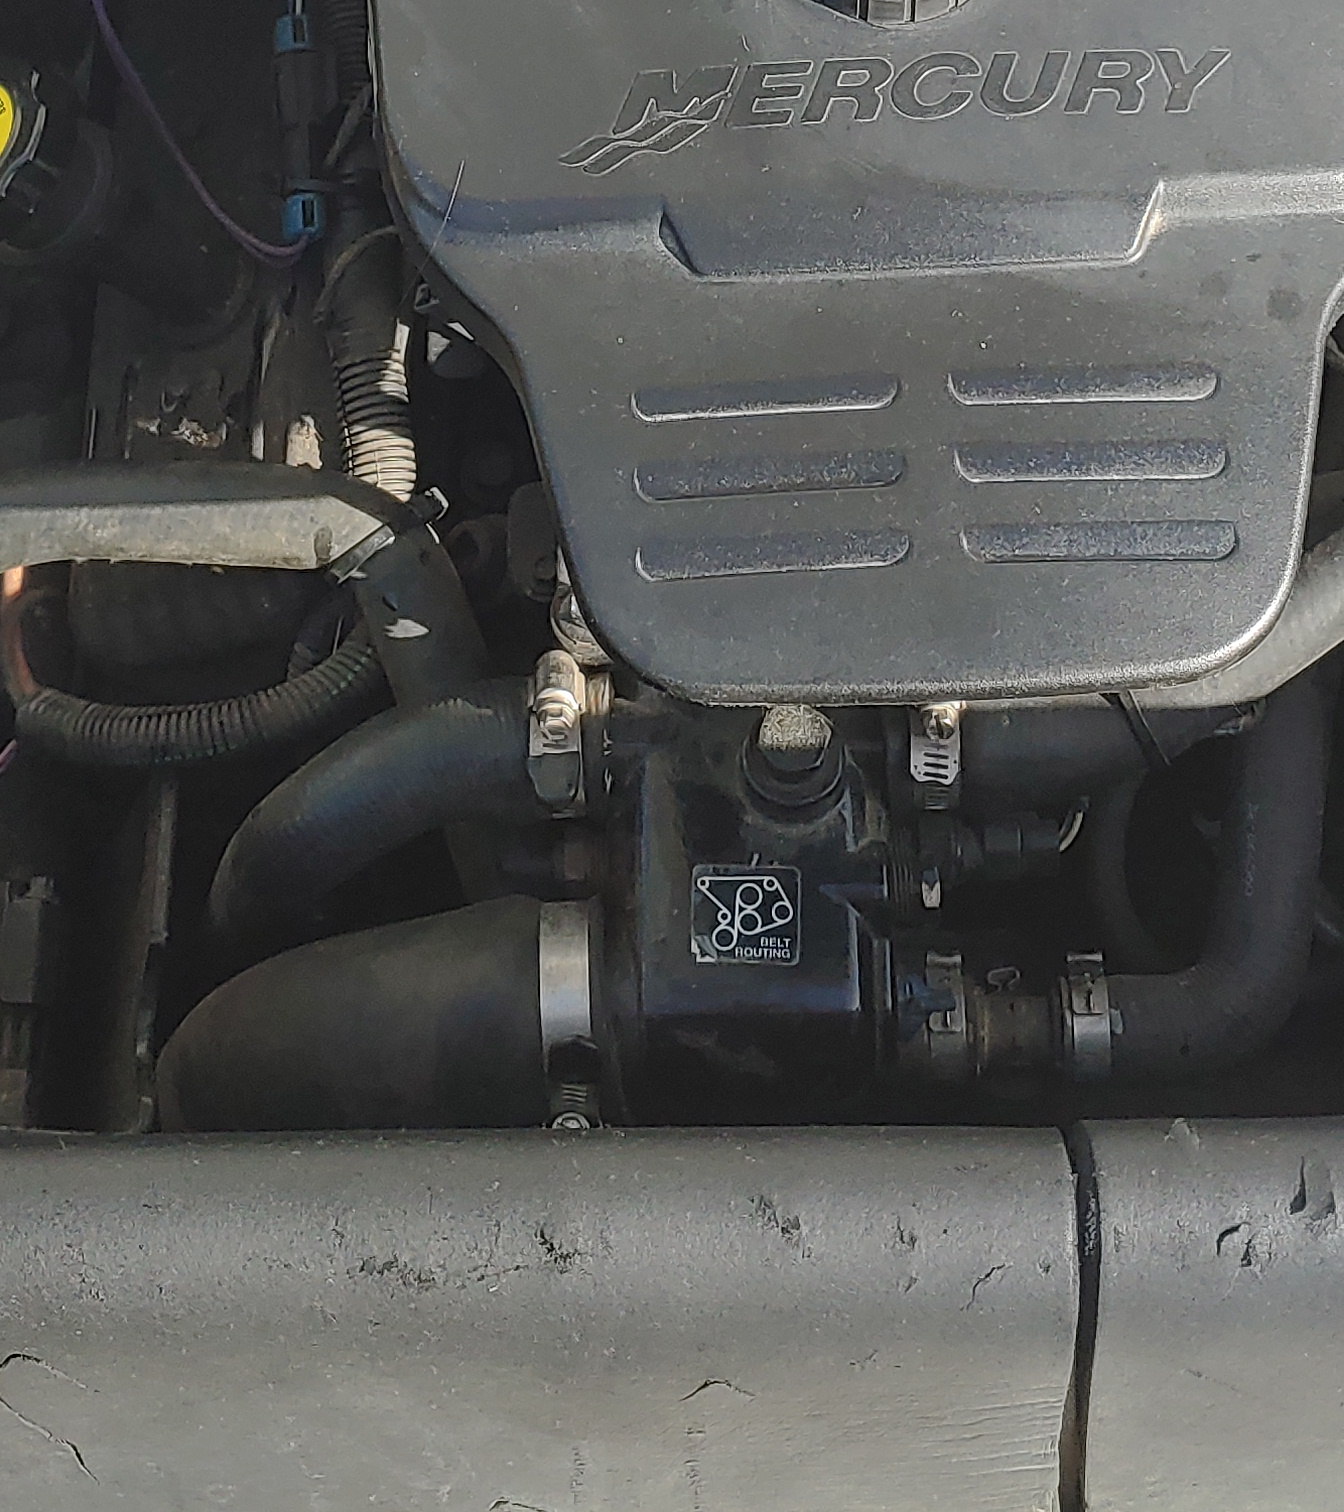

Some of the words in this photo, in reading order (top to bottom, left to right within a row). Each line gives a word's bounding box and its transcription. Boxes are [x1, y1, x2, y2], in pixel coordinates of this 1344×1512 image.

[601, 48, 1232, 138] MERCURY
[759, 936, 793, 948] BELT
[734, 946, 792, 960] ROUTING
